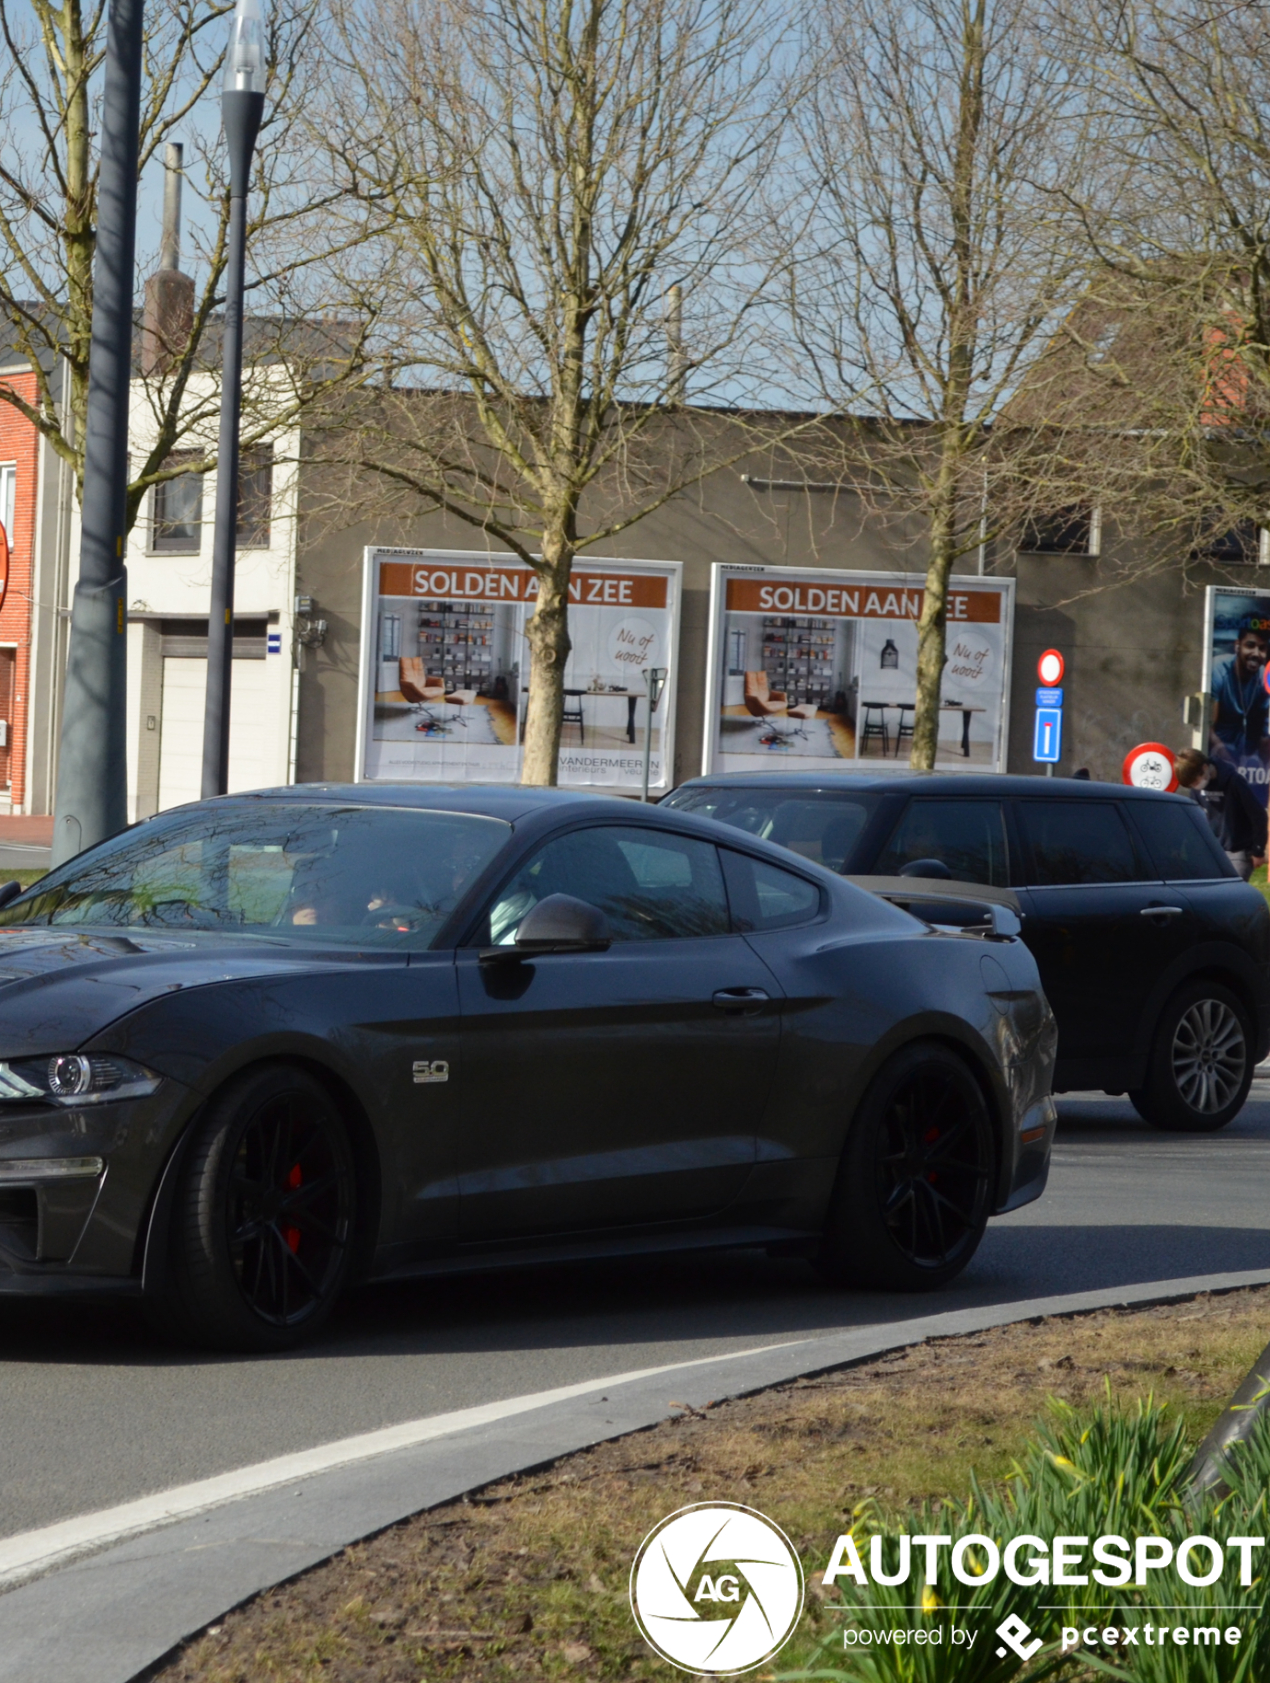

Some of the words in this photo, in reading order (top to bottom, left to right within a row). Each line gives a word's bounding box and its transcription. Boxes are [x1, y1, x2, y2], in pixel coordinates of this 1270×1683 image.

[415, 570, 518, 598] SOLDEN
[524, 576, 581, 600] AN
[587, 579, 633, 603] ZEE
[759, 586, 859, 613] SOLDEN
[864, 592, 919, 617] AAN
[946, 596, 969, 618] EE
[617, 628, 636, 645] Nu
[639, 634, 655, 650] of
[615, 650, 648, 665] nooit
[953, 643, 972, 659] Nu
[974, 648, 990, 665] of
[951, 664, 984, 679] nooit
[560, 756, 660, 769] VANDERMEERN
[624, 768, 660, 776] veune
[413, 1060, 449, 1080] 5.0
